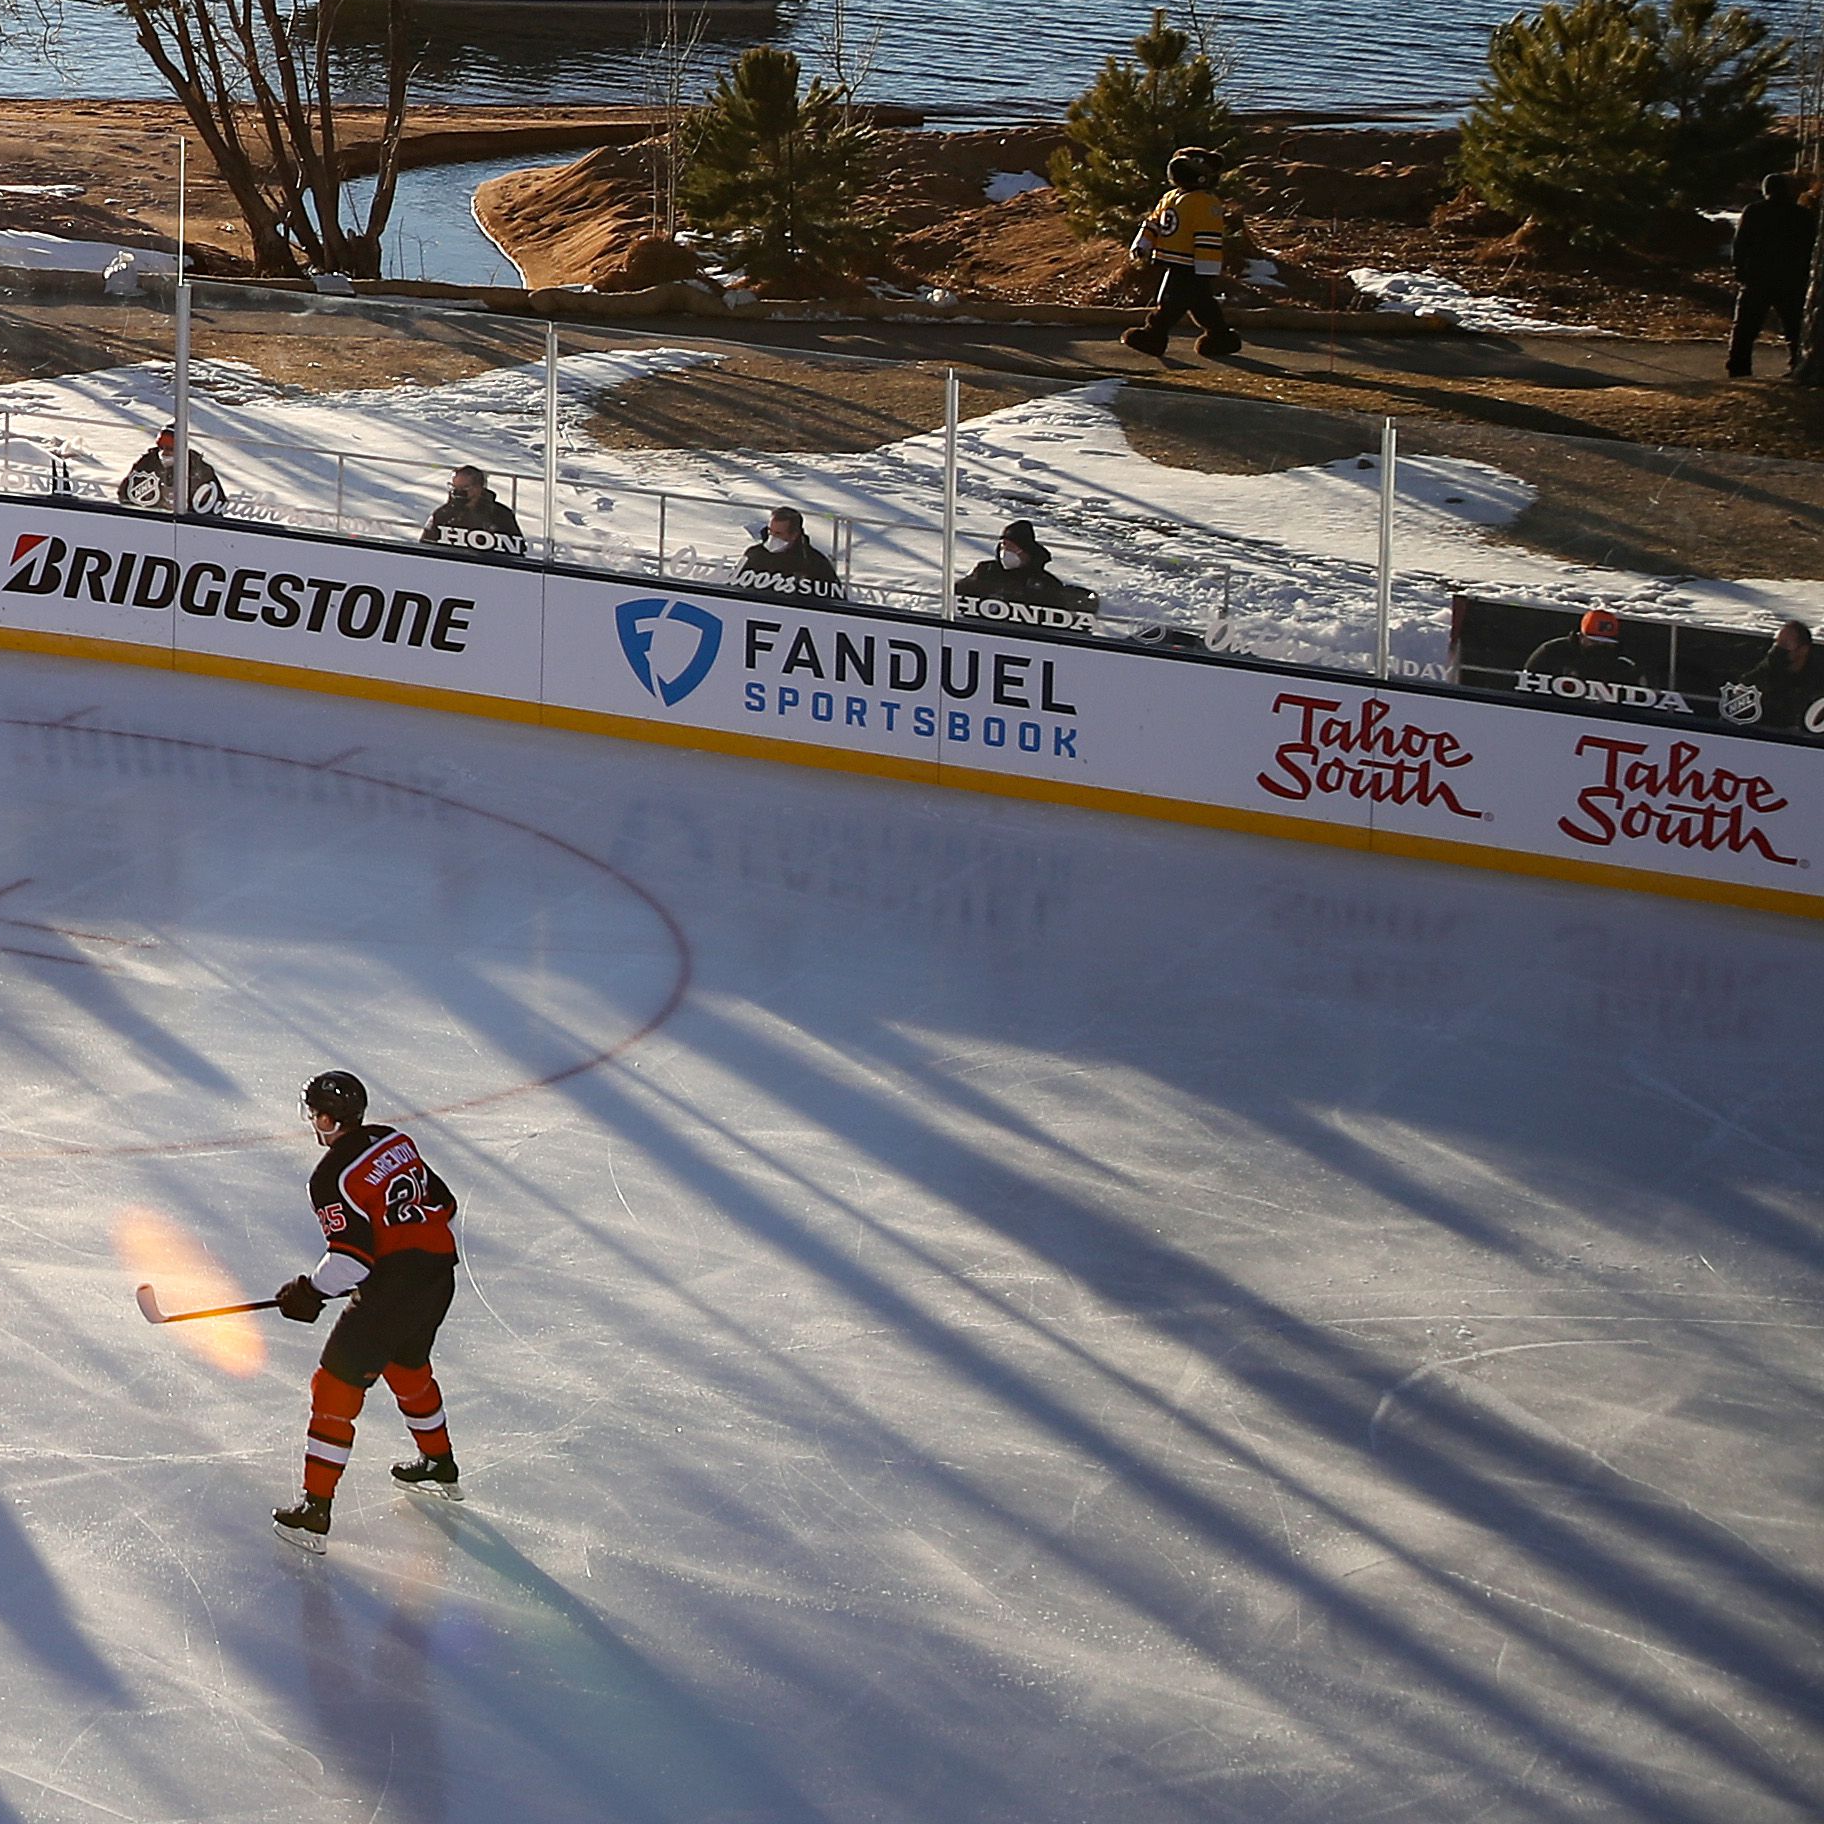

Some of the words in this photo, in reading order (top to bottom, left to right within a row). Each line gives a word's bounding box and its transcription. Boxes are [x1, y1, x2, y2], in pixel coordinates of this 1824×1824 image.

[2, 533, 476, 654] BRIDGESTONE
[670, 544, 797, 594] Outdoors
[951, 595, 1099, 632] HONDA
[744, 618, 1078, 717] FANDUEL
[1514, 671, 1693, 714] HONDA
[744, 680, 1078, 759] SPORTSBOOK
[1273, 693, 1472, 767] Tahoe
[1257, 742, 1482, 819] South
[1574, 734, 1789, 813] Tahoe
[1558, 787, 1798, 866] South
[317, 1202, 348, 1236] 25
